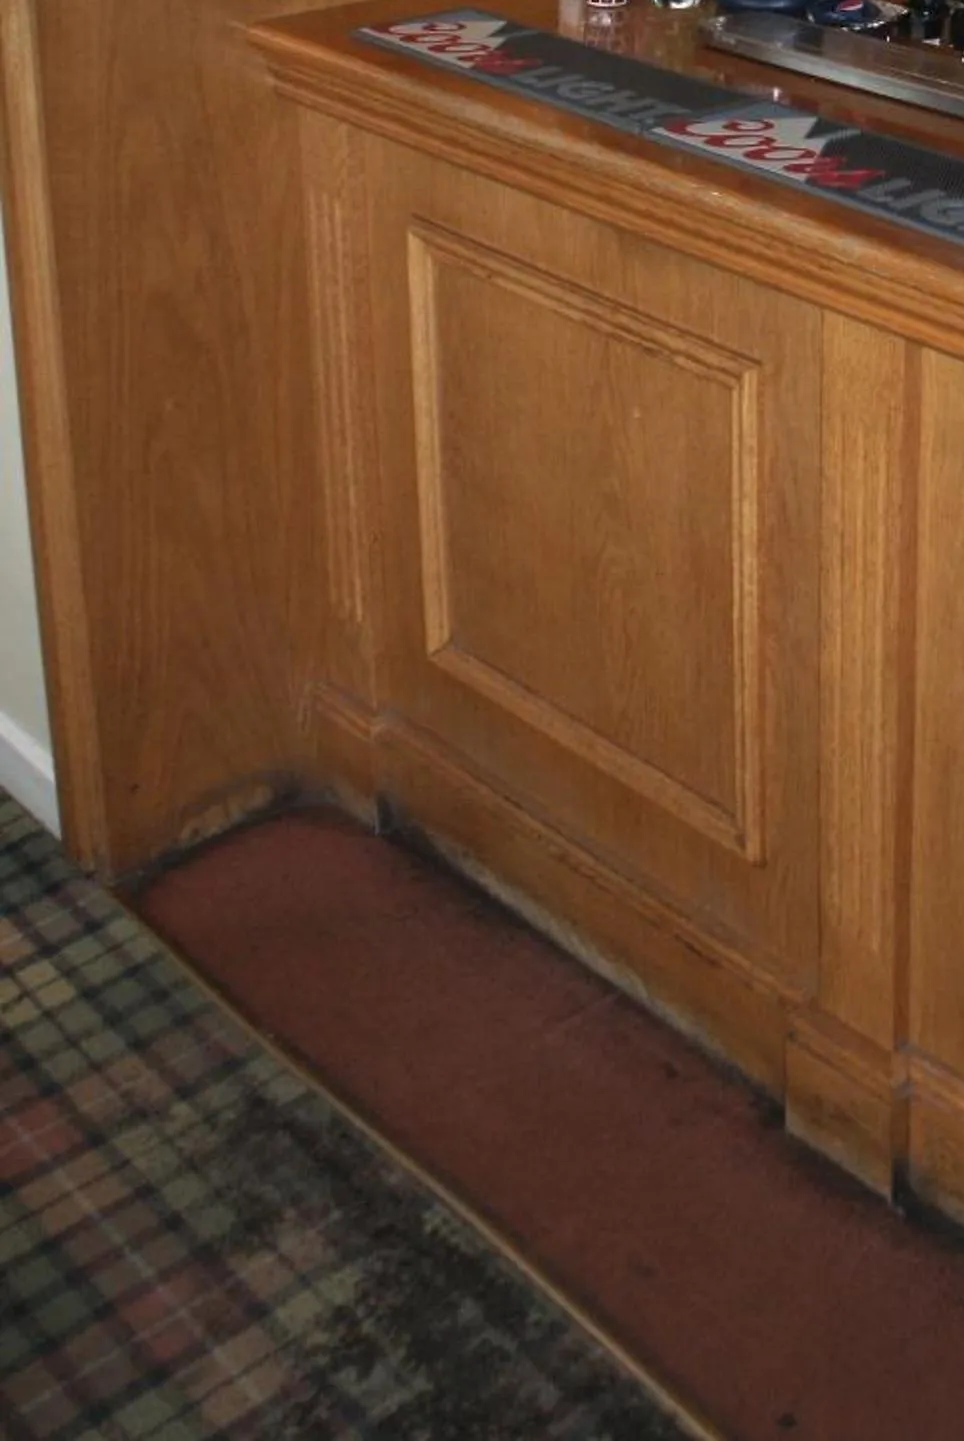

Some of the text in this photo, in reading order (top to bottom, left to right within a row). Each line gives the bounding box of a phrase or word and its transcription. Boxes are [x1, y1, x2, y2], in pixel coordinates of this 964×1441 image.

[370, 21, 690, 121] Coors LIGHT
[662, 118, 884, 190] Coors
